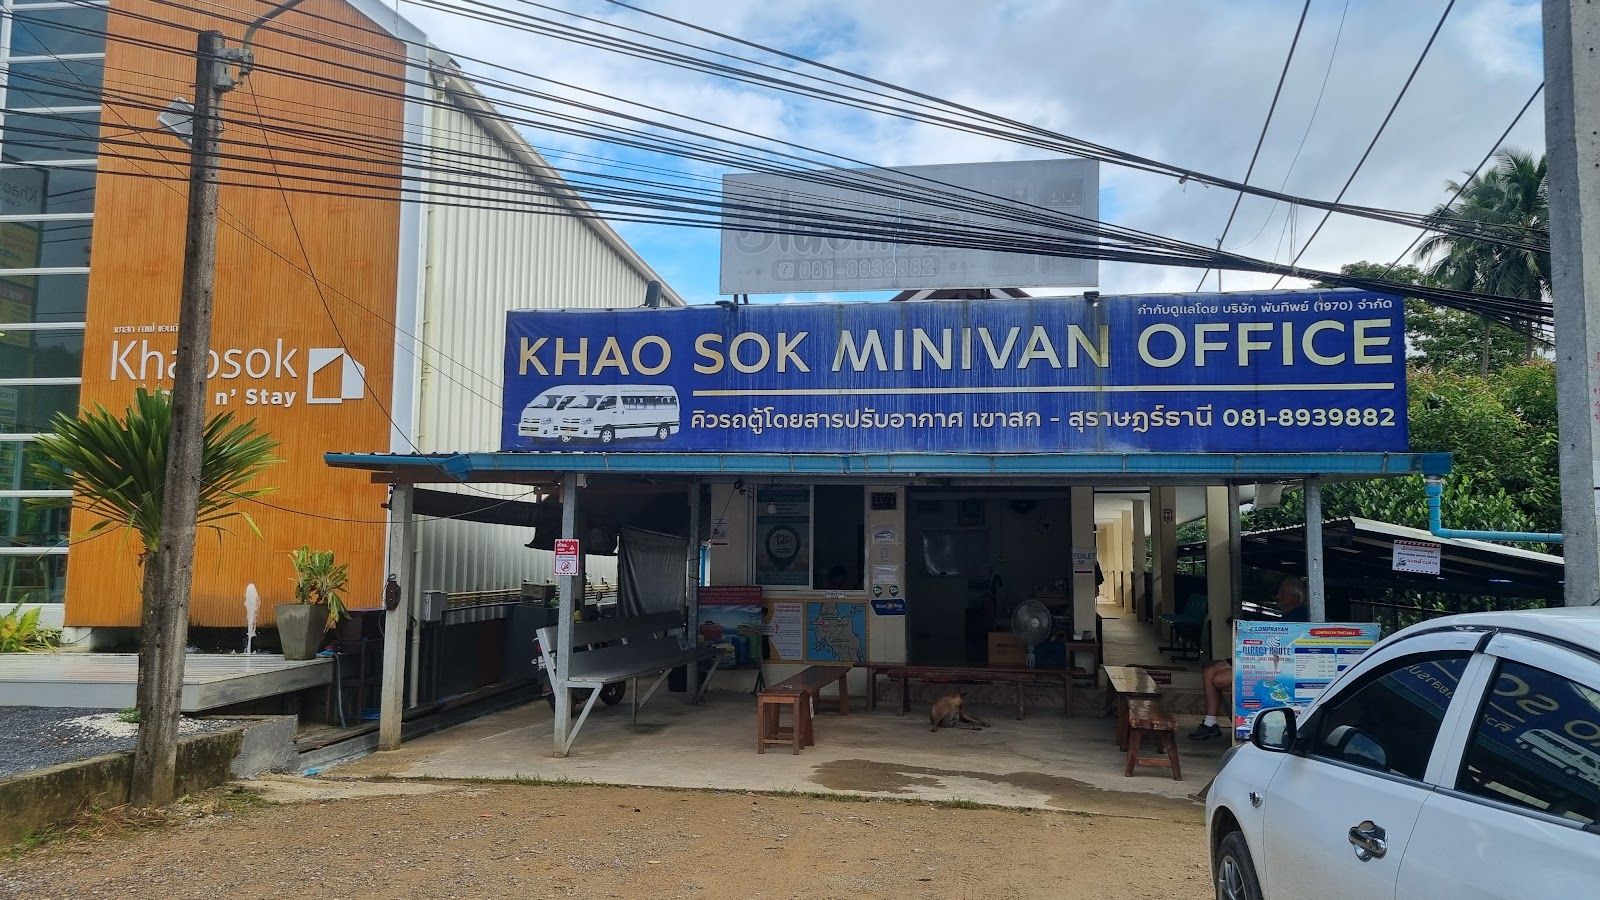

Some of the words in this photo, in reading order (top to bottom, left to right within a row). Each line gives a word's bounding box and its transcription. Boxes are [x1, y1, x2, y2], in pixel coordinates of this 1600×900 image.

[1137, 302, 1218, 317] กำกับดูแลโดย
[1222, 302, 1257, 315] บริษัท
[1260, 300, 1309, 313] พันทิพย์
[1313, 299, 1353, 313] (1970)
[1358, 298, 1393, 310] จำกัด
[518, 336, 671, 376] KHAO
[693, 331, 811, 374] SOK
[831, 327, 1110, 373] MINIVAN
[1137, 318, 1393, 368] OFFICE
[245, 388, 297, 408] Stay
[690, 408, 963, 436] คิวรถตู้โดยสารปรับอากาศ
[973, 407, 1041, 428] เขาสก
[1222, 406, 1396, 428] 081-8939882
[1072, 552, 1097, 560] TOILET
